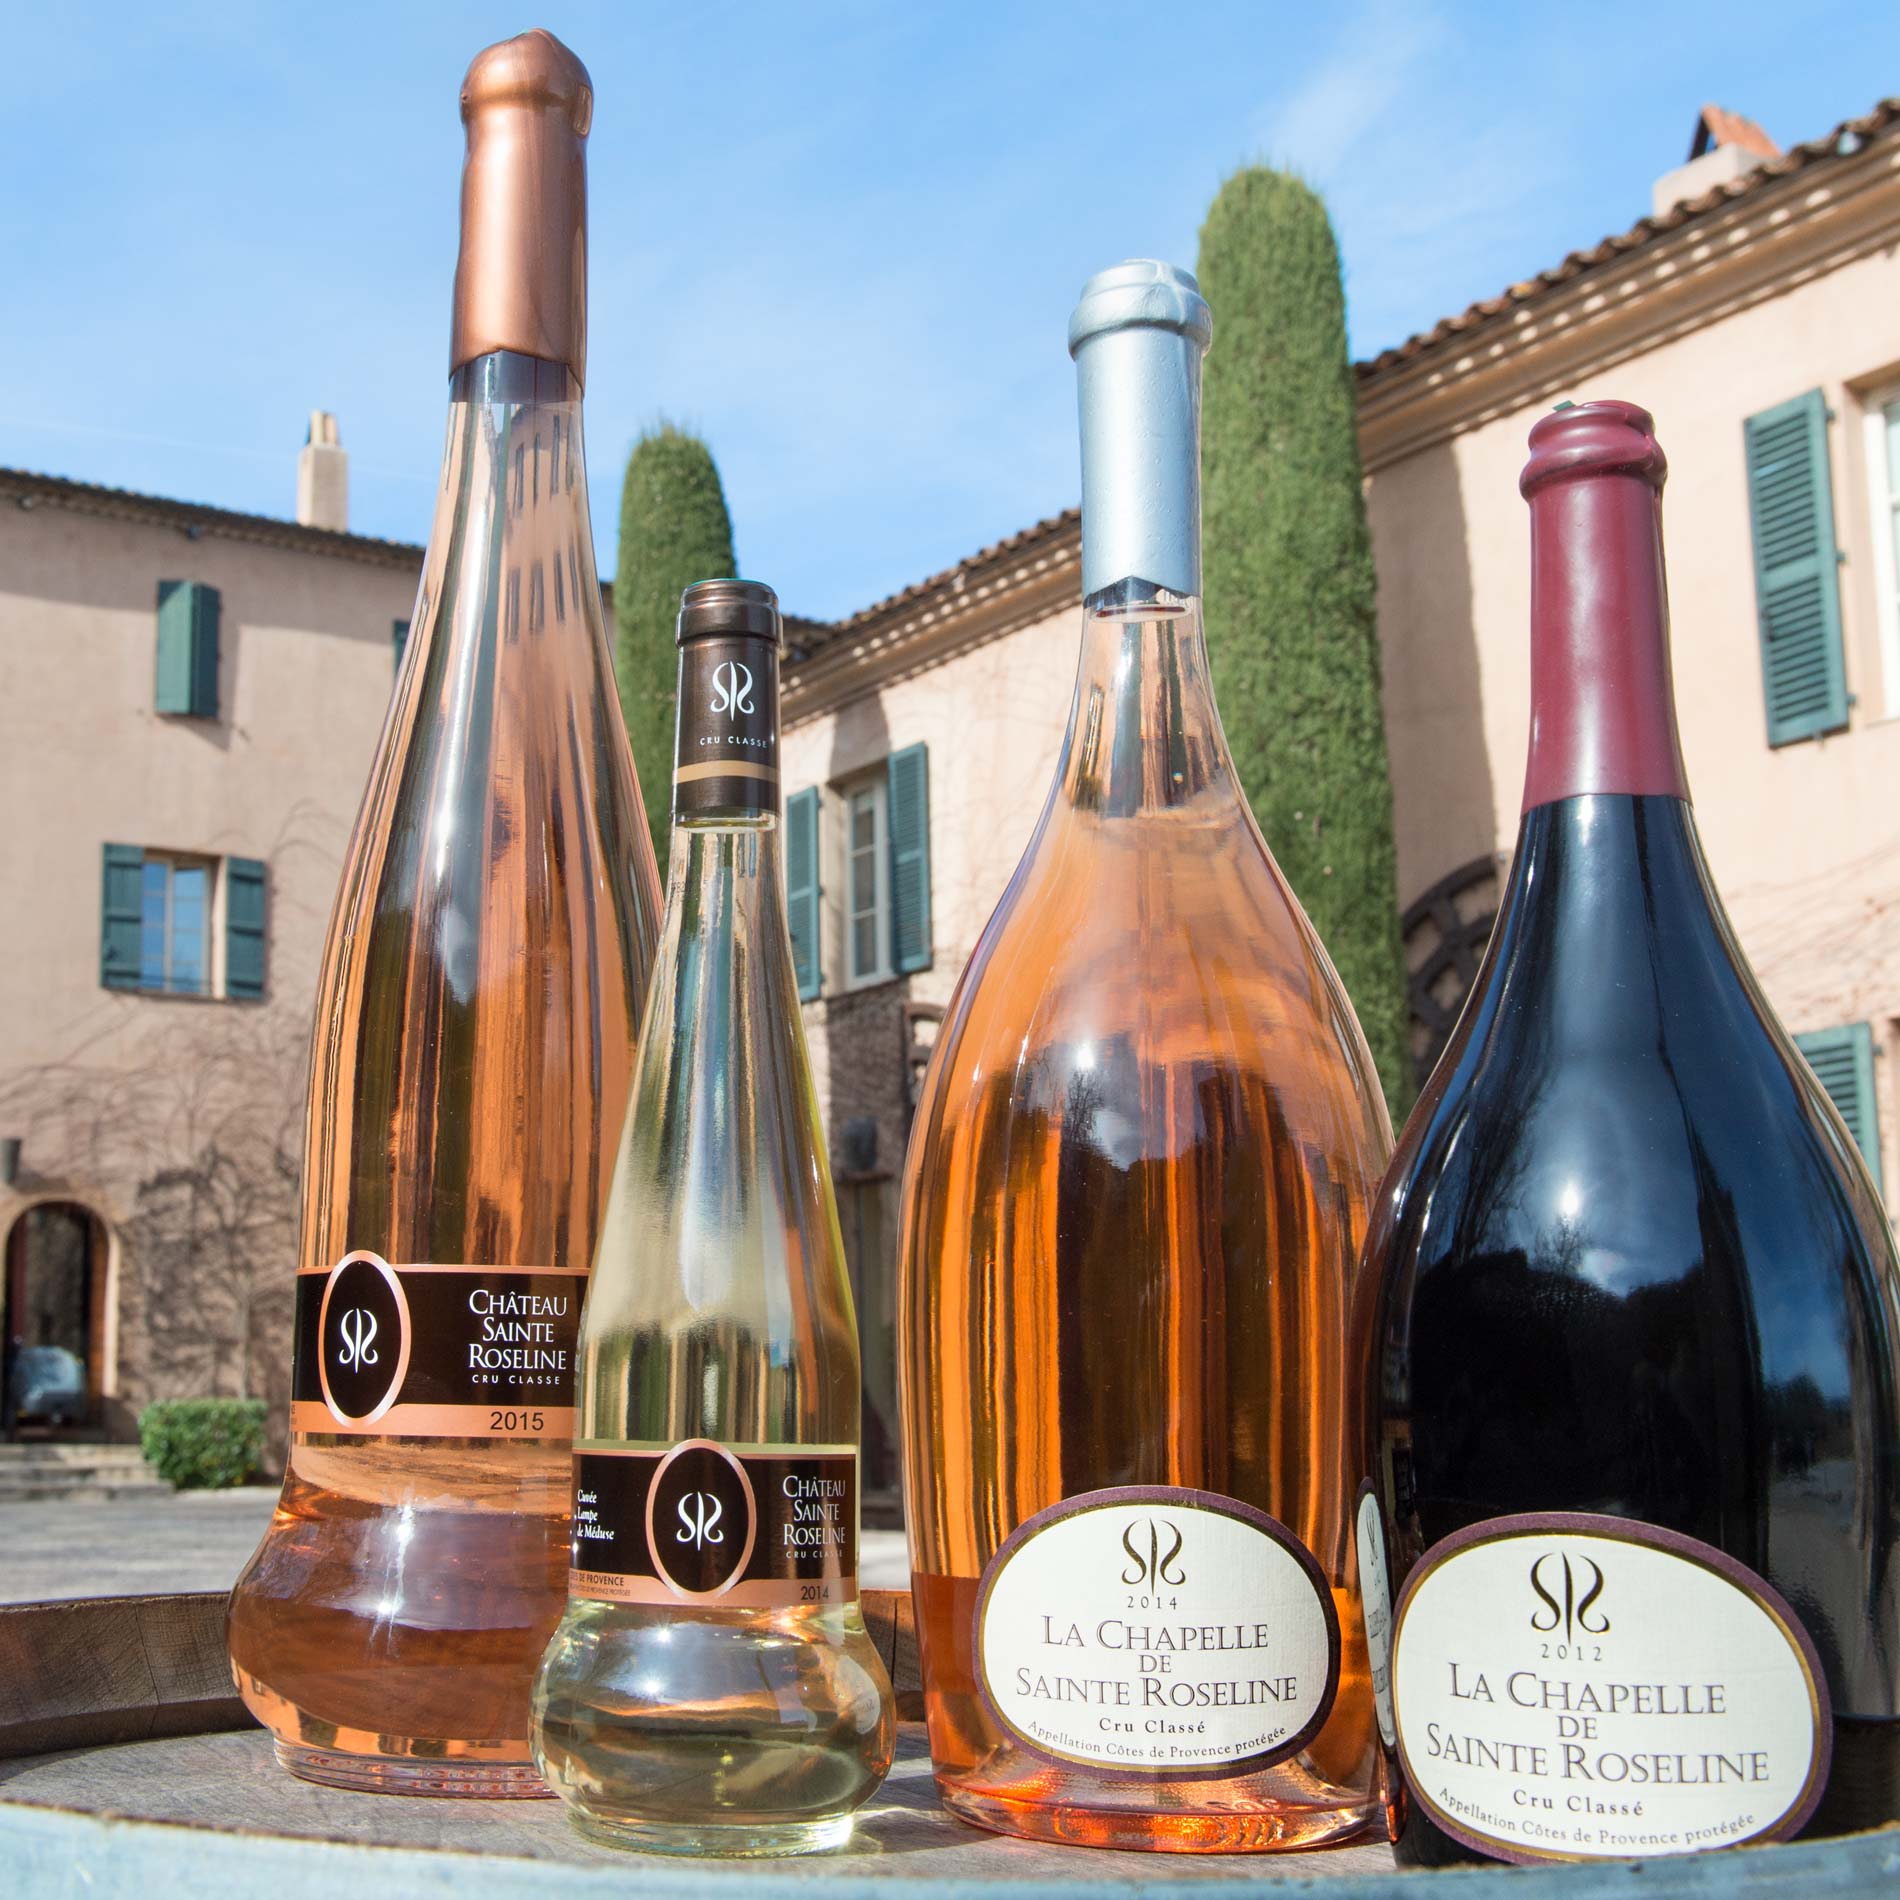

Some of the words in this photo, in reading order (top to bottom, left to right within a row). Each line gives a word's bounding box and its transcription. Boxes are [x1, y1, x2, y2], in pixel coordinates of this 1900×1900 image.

[700, 736, 720, 746] CRU
[727, 735, 767, 748] CLASSE
[468, 1289, 567, 1317] CHÂTEAU
[482, 1317, 554, 1343] SAINTE
[468, 1343, 567, 1370] ROSELINE
[472, 1374, 499, 1384] CRU
[508, 1375, 560, 1385] CLASSE
[490, 1411, 544, 1431] 2015
[782, 1475, 846, 1498] CHÂTEAU
[793, 1499, 840, 1522] SAINTE
[783, 1523, 846, 1546] ROSELINE
[786, 1550, 807, 1559] CRU
[586, 1574, 624, 1586] PROVENCE
[800, 1585, 829, 1601] 2014
[1127, 1595, 1178, 1610] 2014
[1041, 1615, 1085, 1648] LA
[1096, 1620, 1269, 1651] CHAPELLE
[1138, 1654, 1172, 1673] DE
[1541, 1643, 1603, 1662] 2012
[1016, 1667, 1130, 1706] SAINTE
[1141, 1676, 1298, 1707] ROSELINE
[1449, 1663, 1496, 1703] LA
[1506, 1671, 1726, 1715] CHAPELLE
[1099, 1717, 1134, 1732] Cru
[1145, 1719, 1206, 1734] Classé
[1557, 1715, 1598, 1740] DE
[1027, 1720, 1101, 1753] Appellation
[1106, 1742, 1144, 1757] Côtes
[1150, 1745, 1165, 1758] de
[1170, 1745, 1231, 1758] Provence
[1235, 1725, 1286, 1754] protégée
[1427, 1723, 1549, 1777] SAINTE
[1560, 1743, 1770, 1785] ROSELINE
[1512, 1789, 1553, 1809] Cru
[1567, 1795, 1643, 1816] Classé
[1439, 1787, 1516, 1831] Appellation
[1522, 1820, 1567, 1841] Côtes
[1573, 1827, 1592, 1843] de
[1599, 1829, 1678, 1845] Provence
[1684, 1813, 1755, 1845] protégée
